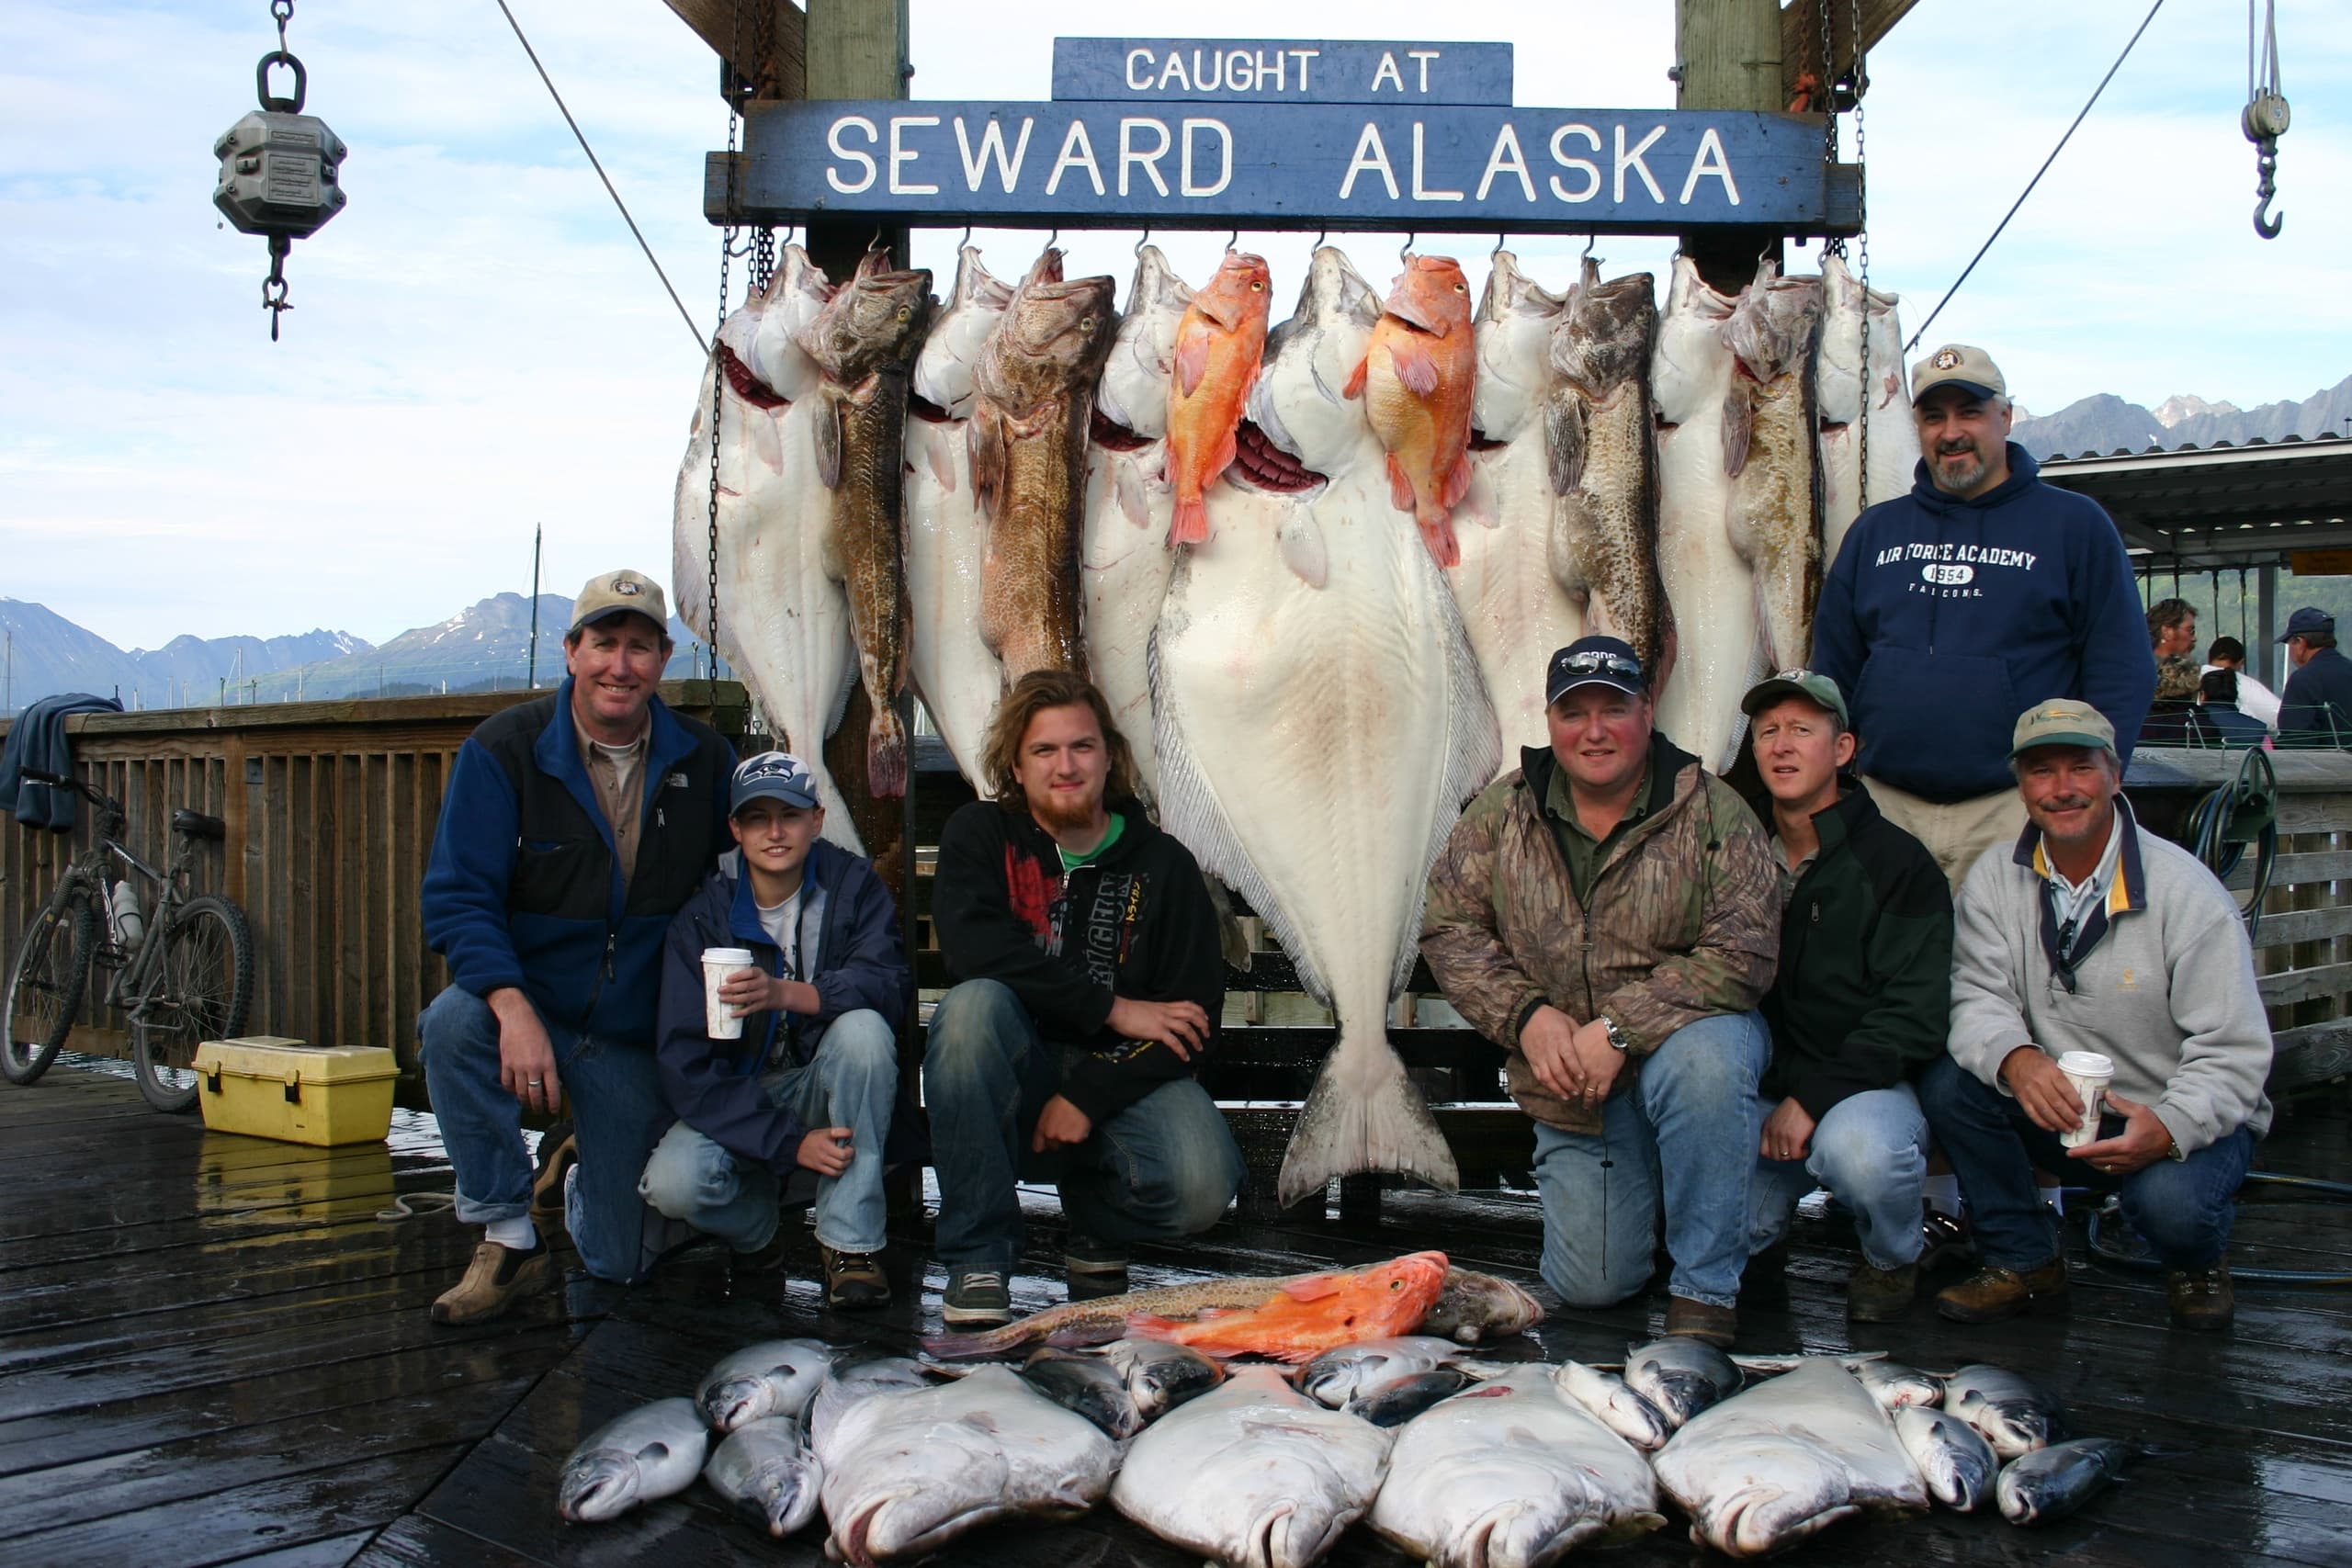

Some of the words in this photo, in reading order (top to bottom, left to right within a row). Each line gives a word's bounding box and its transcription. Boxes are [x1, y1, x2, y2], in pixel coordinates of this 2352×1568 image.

[1125, 48, 1321, 93] CAUGHT
[1370, 51, 1442, 95] AT
[824, 116, 1235, 198] SEWARD
[1338, 121, 1742, 206] ALASKA
[1875, 547, 1904, 568] AIR
[1905, 543, 1953, 562] FORCE
[1955, 544, 2037, 571] ACADEMY
[1929, 568, 1965, 582] 1954
